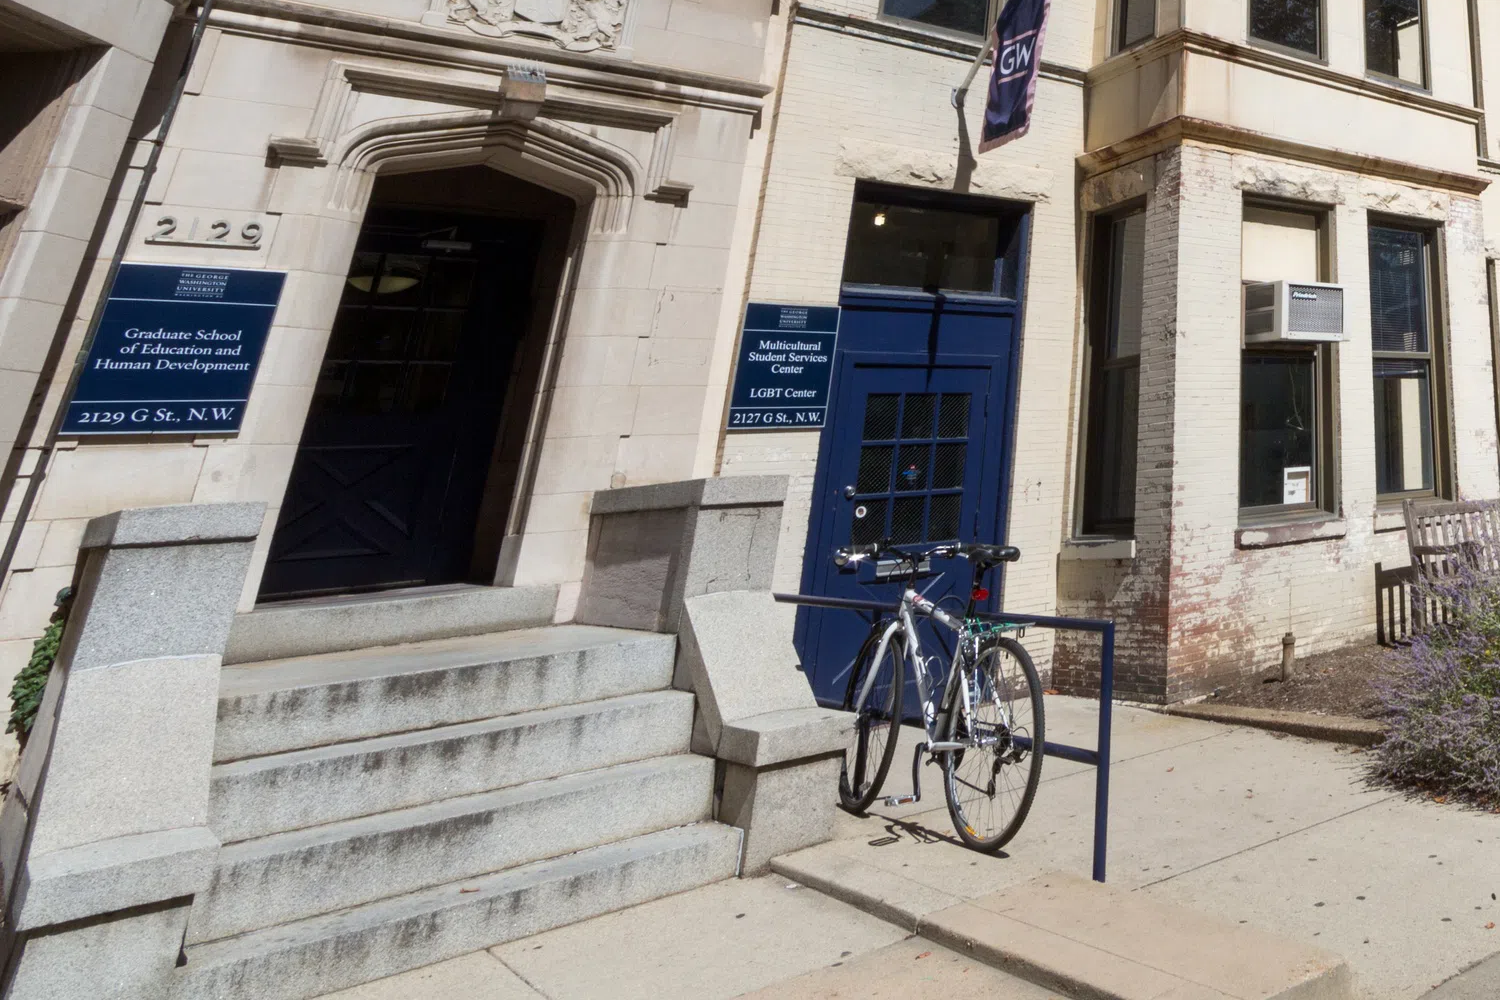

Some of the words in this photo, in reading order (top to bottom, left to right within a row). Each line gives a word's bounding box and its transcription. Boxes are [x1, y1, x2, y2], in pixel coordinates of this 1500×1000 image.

[1000, 37, 1036, 75] GW
[150, 215, 263, 244] 2129
[124, 328, 192, 340] Graduate
[195, 330, 242, 341] School
[120, 343, 140, 354] of
[140, 344, 212, 355] Education
[214, 345, 242, 356] and
[758, 340, 822, 351] Multicultural
[748, 352, 786, 362] Student
[788, 353, 828, 363] Services
[94, 359, 151, 370] Human
[154, 359, 251, 374] Development
[771, 364, 804, 374] Center
[749, 388, 783, 398] LGBT
[784, 388, 817, 398] Center
[77, 412, 125, 426] 2129
[131, 408, 149, 423] G
[153, 408, 181, 423] St.,
[186, 407, 235, 422] N.W.
[733, 413, 761, 424] 2127
[763, 412, 773, 423] G
[775, 412, 793, 424] St.,
[795, 411, 821, 422] N.W.
